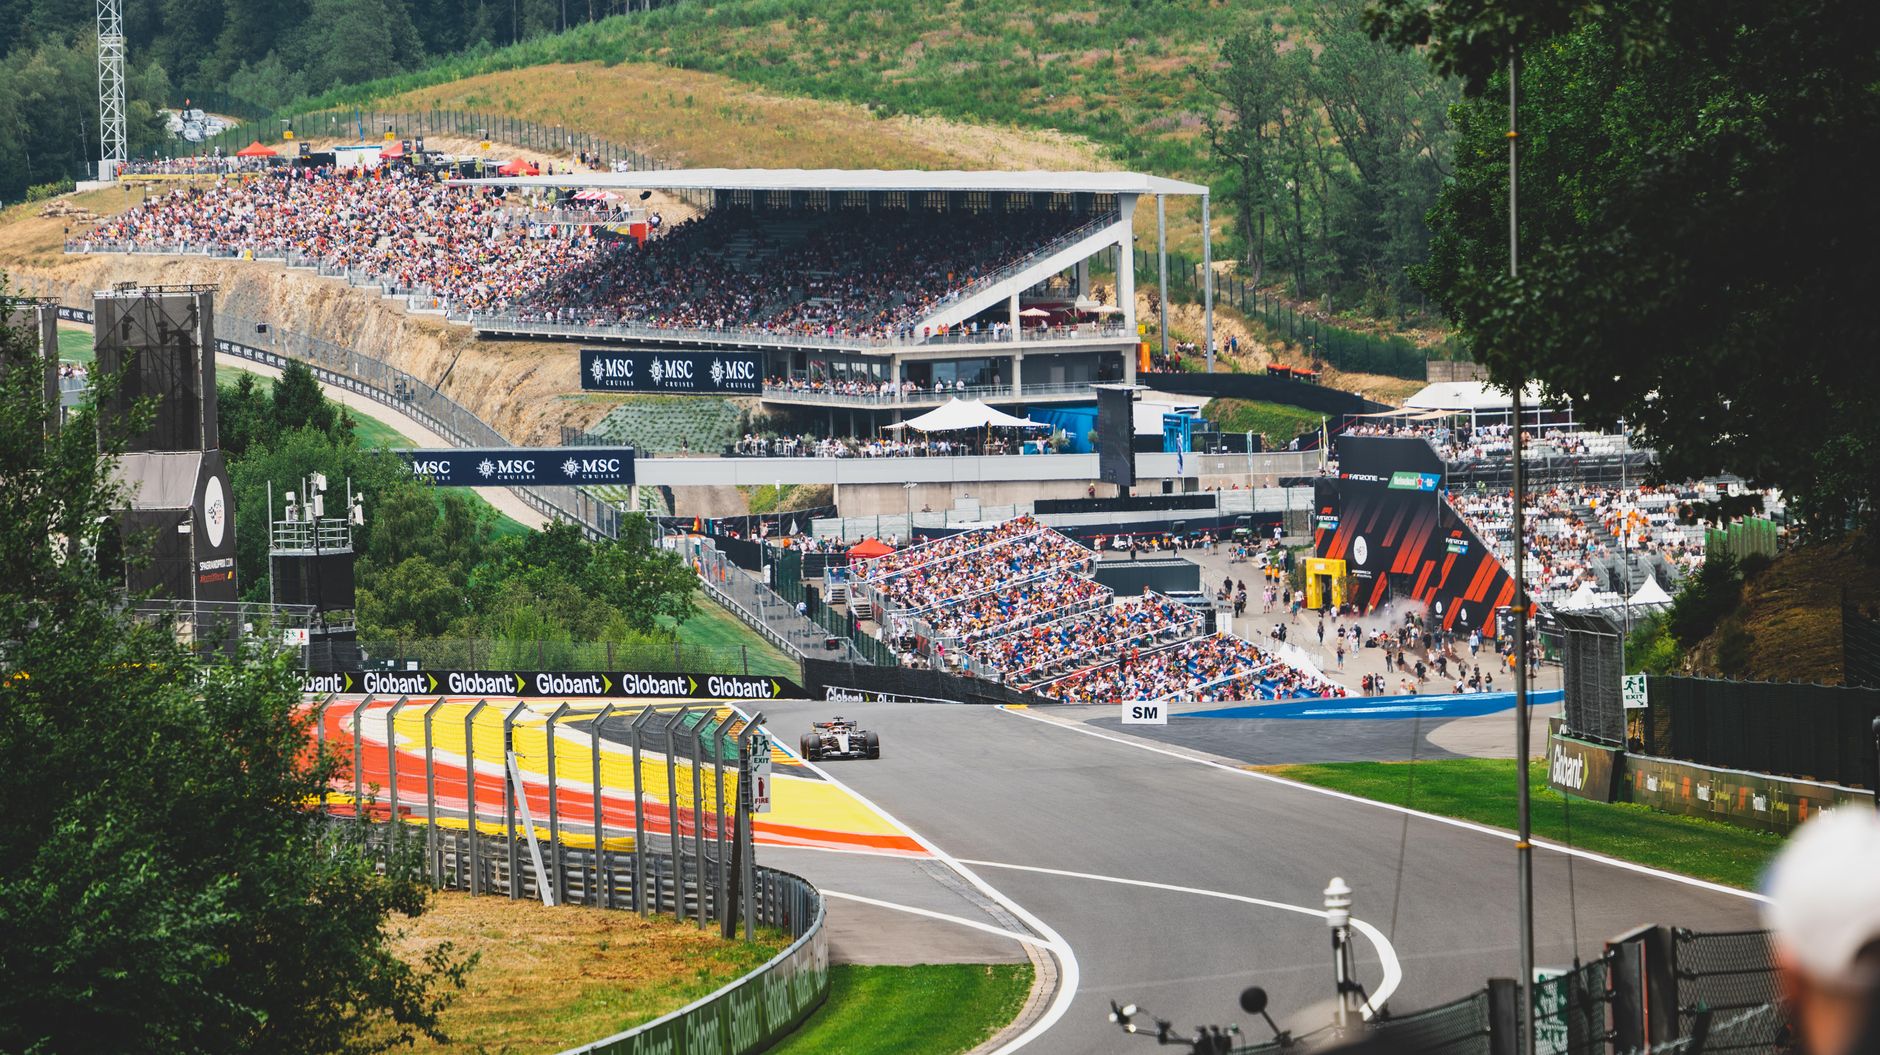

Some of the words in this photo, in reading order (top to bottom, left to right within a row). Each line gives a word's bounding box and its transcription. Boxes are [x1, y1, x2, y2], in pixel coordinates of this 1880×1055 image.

[605, 358, 634, 378] MSC
[664, 360, 693, 379] MSC
[725, 360, 754, 380] MSC
[605, 379, 634, 387] CRUISES
[665, 380, 694, 388] CRUISES
[412, 460, 451, 474] MSC
[497, 459, 535, 473] MSC
[582, 458, 620, 473] MSC
[1348, 473, 1378, 482] FANZONE
[363, 671, 427, 694] Globant
[448, 672, 515, 694] Globant
[536, 673, 602, 694] Globant
[622, 673, 688, 695] Globant
[707, 676, 771, 698] Globant
[1132, 706, 1158, 719] SM
[1552, 743, 1583, 791] Globant
